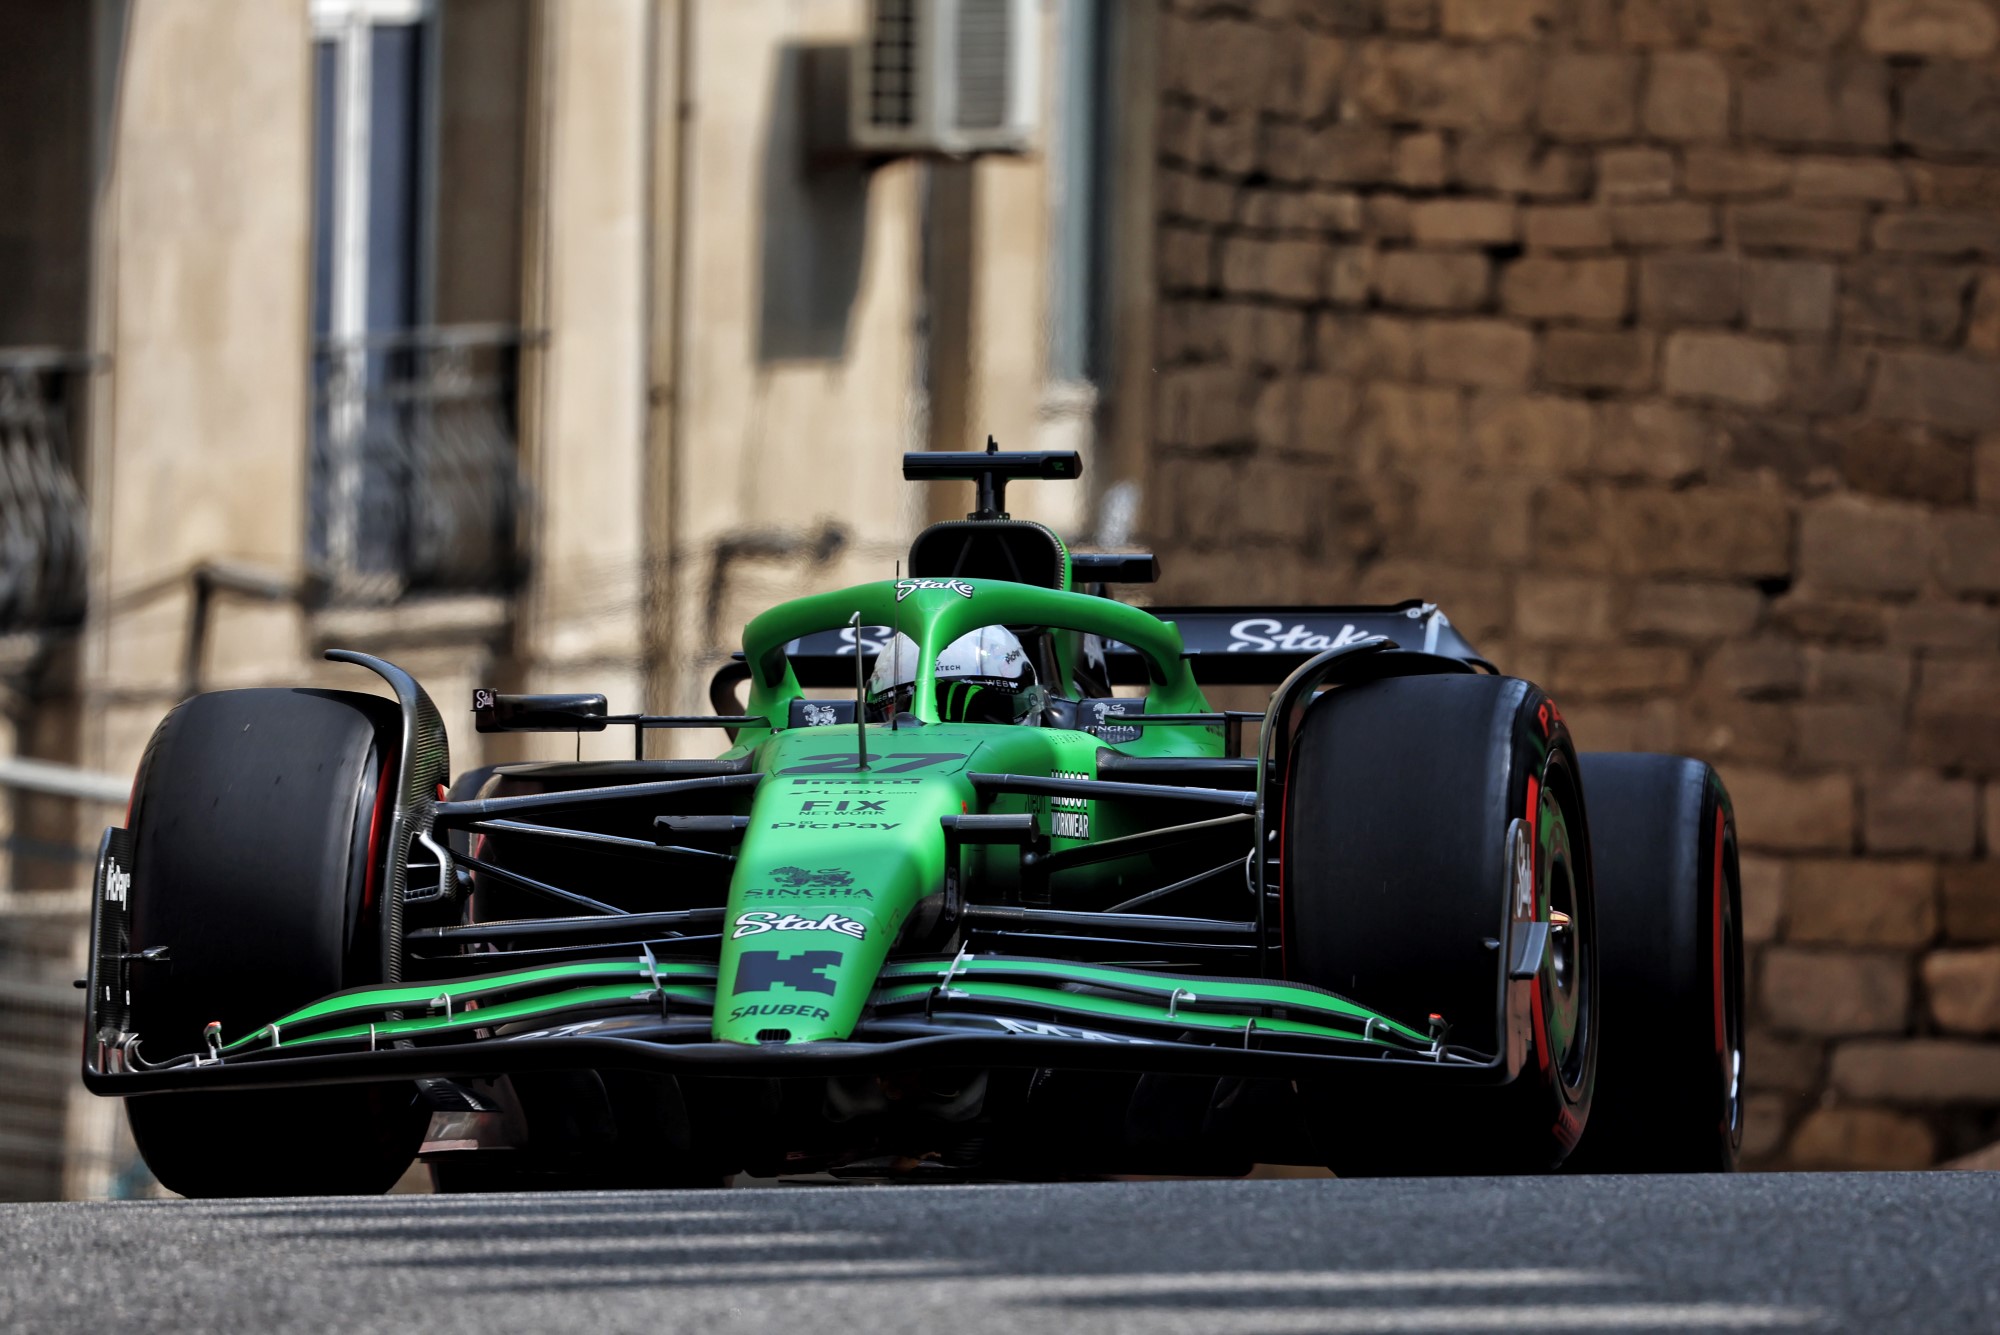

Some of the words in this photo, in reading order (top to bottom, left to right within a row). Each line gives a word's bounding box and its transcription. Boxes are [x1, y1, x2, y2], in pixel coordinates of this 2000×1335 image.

[895, 579, 974, 601] Stake
[1227, 618, 1390, 652] Stak
[779, 752, 968, 774] 27
[801, 800, 889, 811] FIX
[771, 821, 902, 831] PicPay
[1052, 812, 1090, 838] WORKWEAR
[744, 888, 873, 898] SINGHA
[731, 911, 867, 940] Stake
[728, 1004, 830, 1023] SAUBER
